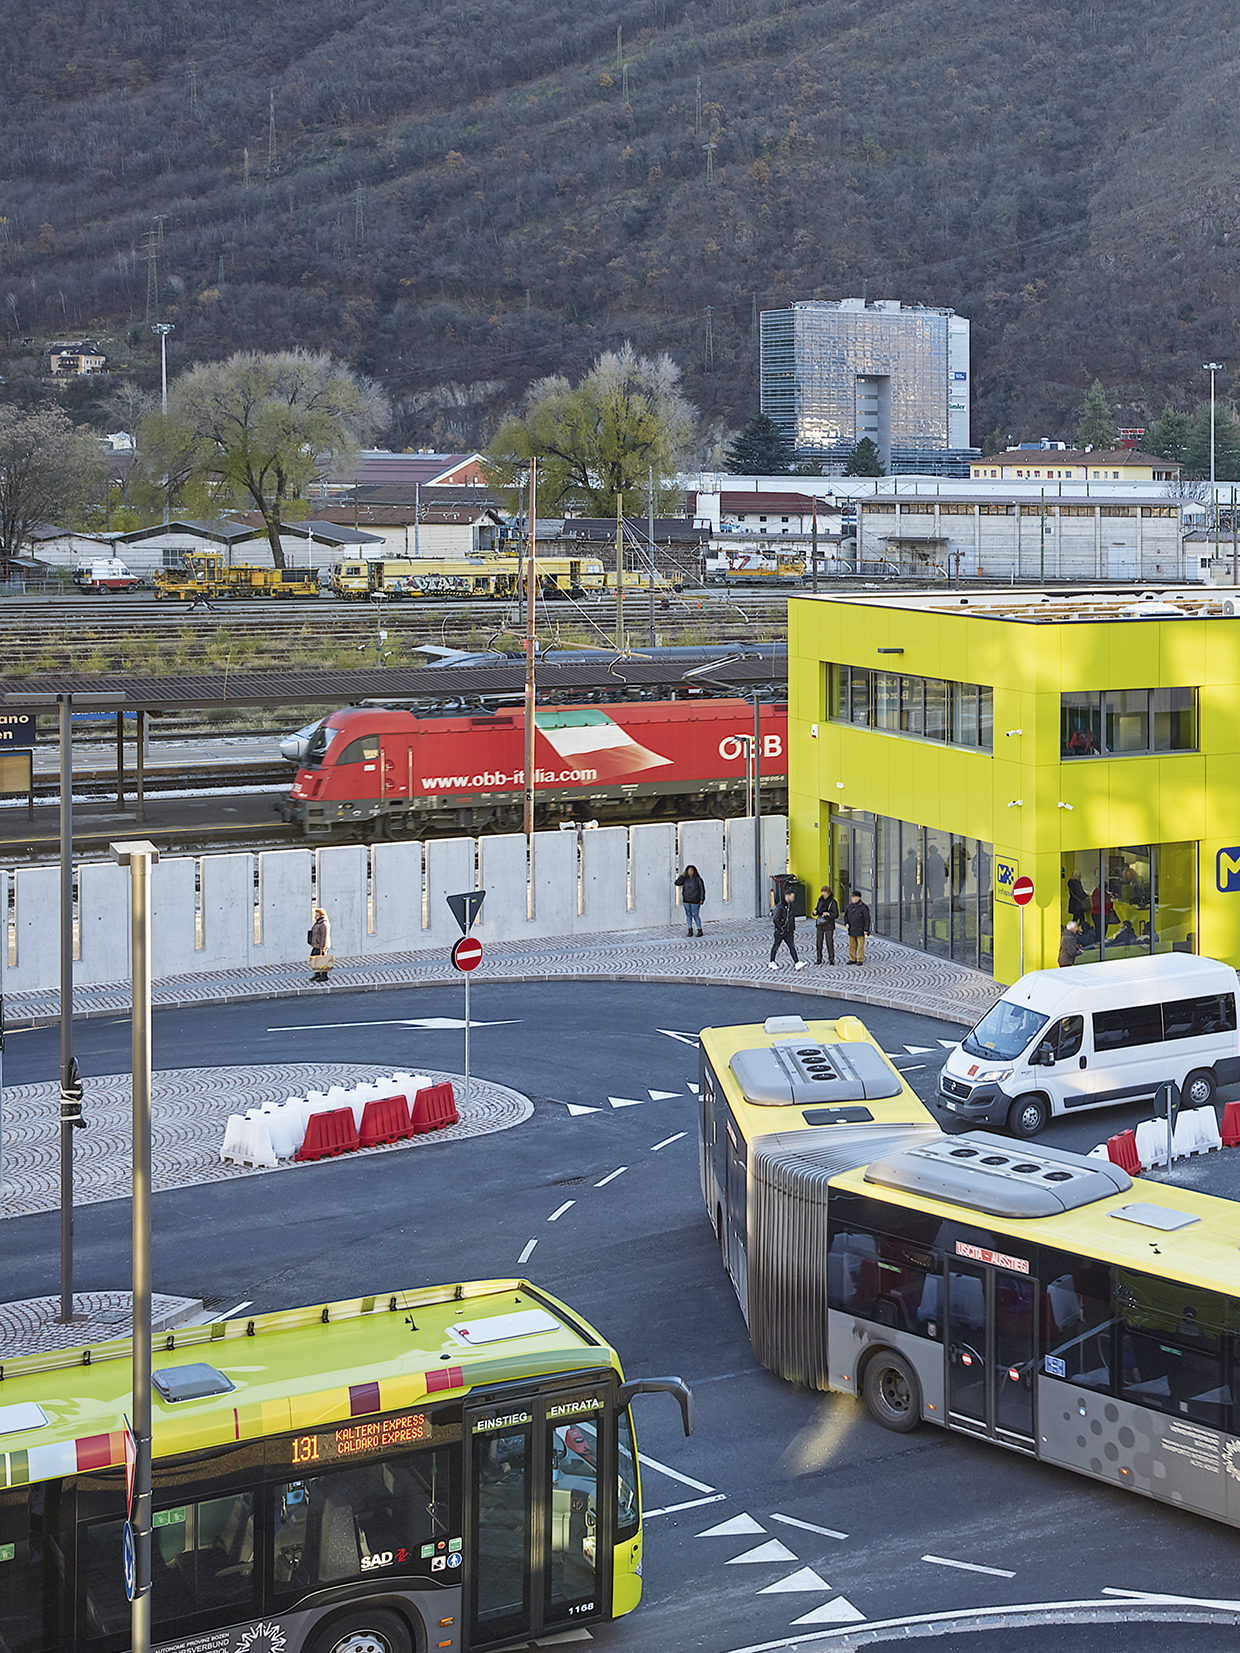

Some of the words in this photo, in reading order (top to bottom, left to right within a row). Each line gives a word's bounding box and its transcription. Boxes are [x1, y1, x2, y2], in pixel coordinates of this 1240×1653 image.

[421, 768, 598, 789] www.obb-itlia.com
[477, 1412, 527, 1431] EINSTIEG
[551, 1399, 599, 1416] ENTRATA
[291, 1435, 319, 1464] 131
[335, 1422, 381, 1442] KALTERN
[383, 1413, 425, 1432] EXPRESS
[337, 1435, 379, 1454] CALDARO
[381, 1427, 424, 1445] EXPRESS
[360, 1551, 393, 1569] SAD
[568, 1602, 594, 1615] 1168
[187, 1636, 210, 1647] PROVINZ
[211, 1632, 230, 1642] BOZEN
